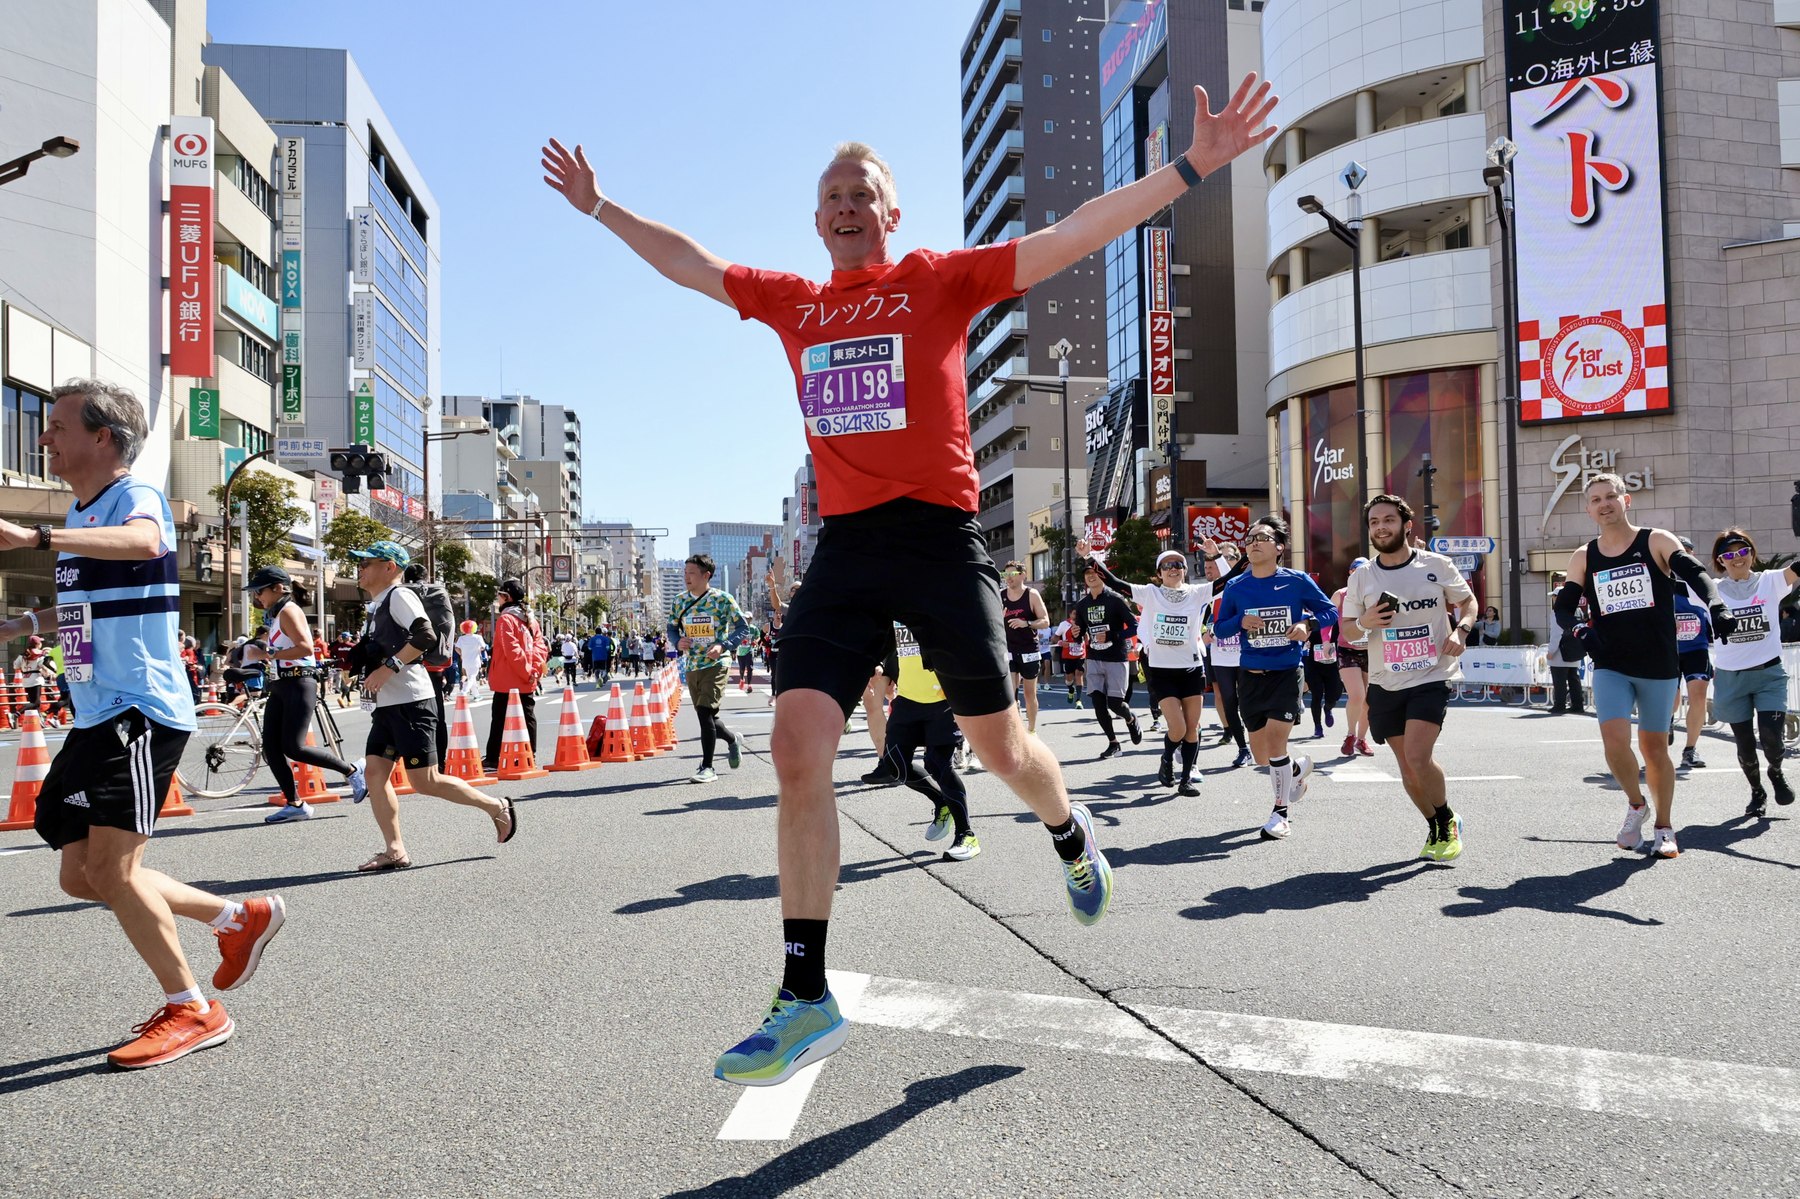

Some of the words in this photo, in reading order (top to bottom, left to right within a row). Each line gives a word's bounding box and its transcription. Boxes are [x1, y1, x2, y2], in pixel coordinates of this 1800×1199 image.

[173, 159, 207, 169] MUFG
[179, 202, 201, 342] 三菱UFJ銀行
[286, 260, 298, 298] NOVA
[239, 285, 268, 326] NOVA
[796, 293, 912, 329] アレックス
[1560, 318, 1590, 337] STARDUST
[1591, 318, 1622, 330] STARDUST
[285, 332, 300, 363] 歯科
[832, 343, 889, 361] 東京メトロ
[1547, 337, 1561, 368] STARDUST
[1622, 329, 1640, 358] STARDUST
[1153, 316, 1172, 392] カラオケ
[1562, 341, 1603, 390] Star
[1582, 360, 1623, 378] Dust
[806, 379, 815, 393] F
[822, 368, 889, 405] 61198
[286, 413, 298, 421] 3F
[806, 404, 814, 416] 2
[842, 403, 874, 412] MARATHON
[1085, 405, 1104, 433] BIG
[278, 440, 324, 451] 門前仲町
[1314, 438, 1344, 498] Star
[1324, 463, 1354, 483] Dust
[1543, 434, 1621, 534] Star
[1582, 466, 1654, 494] Dst
[1192, 512, 1246, 540] 銀だこ
[55, 567, 80, 587] Edgar
[1611, 567, 1642, 578] 東京メトロ
[1607, 579, 1644, 598] 86863
[1402, 597, 1438, 612] YORK
[690, 625, 710, 635] 28164
[1161, 625, 1185, 636] 54052
[1398, 628, 1428, 637] 東京メトロ
[1734, 617, 1763, 632] 4742
[1394, 640, 1429, 658] 76388
[64, 797, 90, 808] adidas
